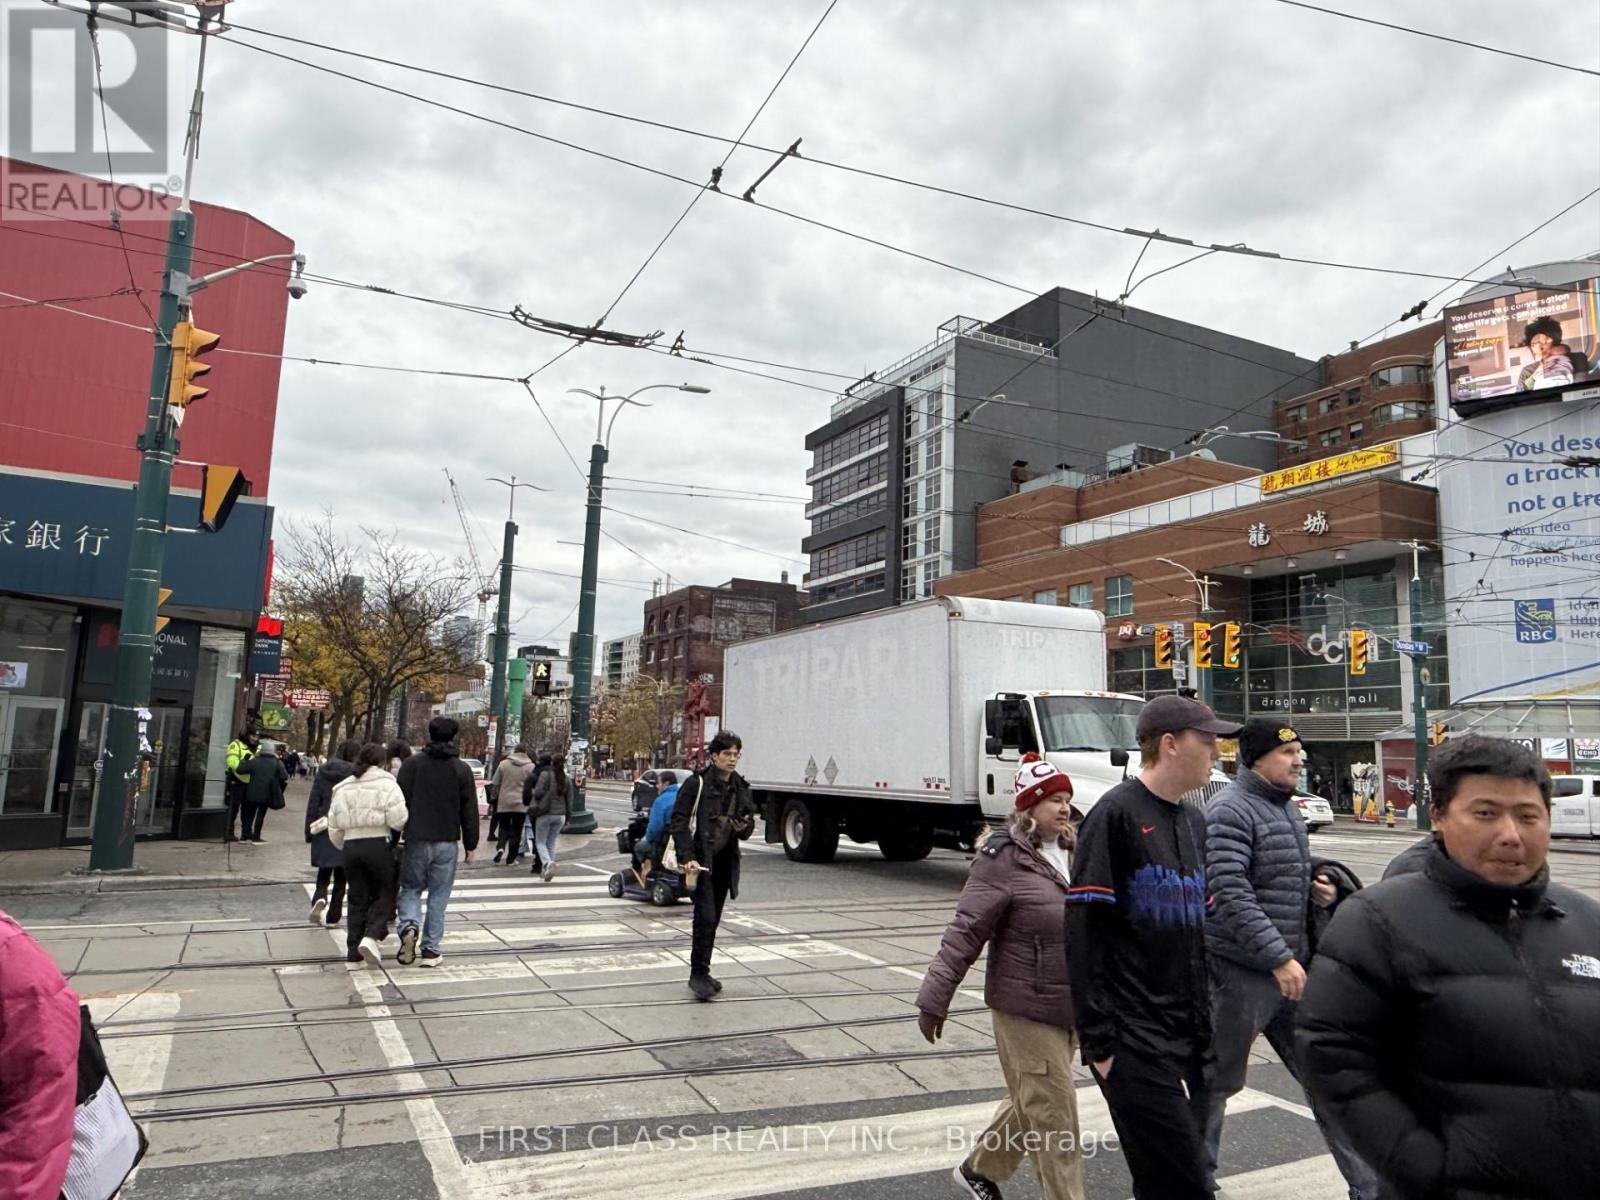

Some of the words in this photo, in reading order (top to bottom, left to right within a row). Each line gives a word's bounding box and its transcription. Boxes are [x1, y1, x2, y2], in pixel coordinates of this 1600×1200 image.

[1504, 440, 1544, 459] You
[1506, 473, 1519, 486] a
[1525, 465, 1589, 483] track
[1508, 495, 1546, 513] not
[1552, 496, 1566, 508] a
[1541, 522, 1570, 533] idea
[1511, 554, 1568, 568] happens
[1520, 630, 1553, 641] RBC
[1262, 696, 1305, 708] dragon
[1348, 692, 1377, 703] mall
